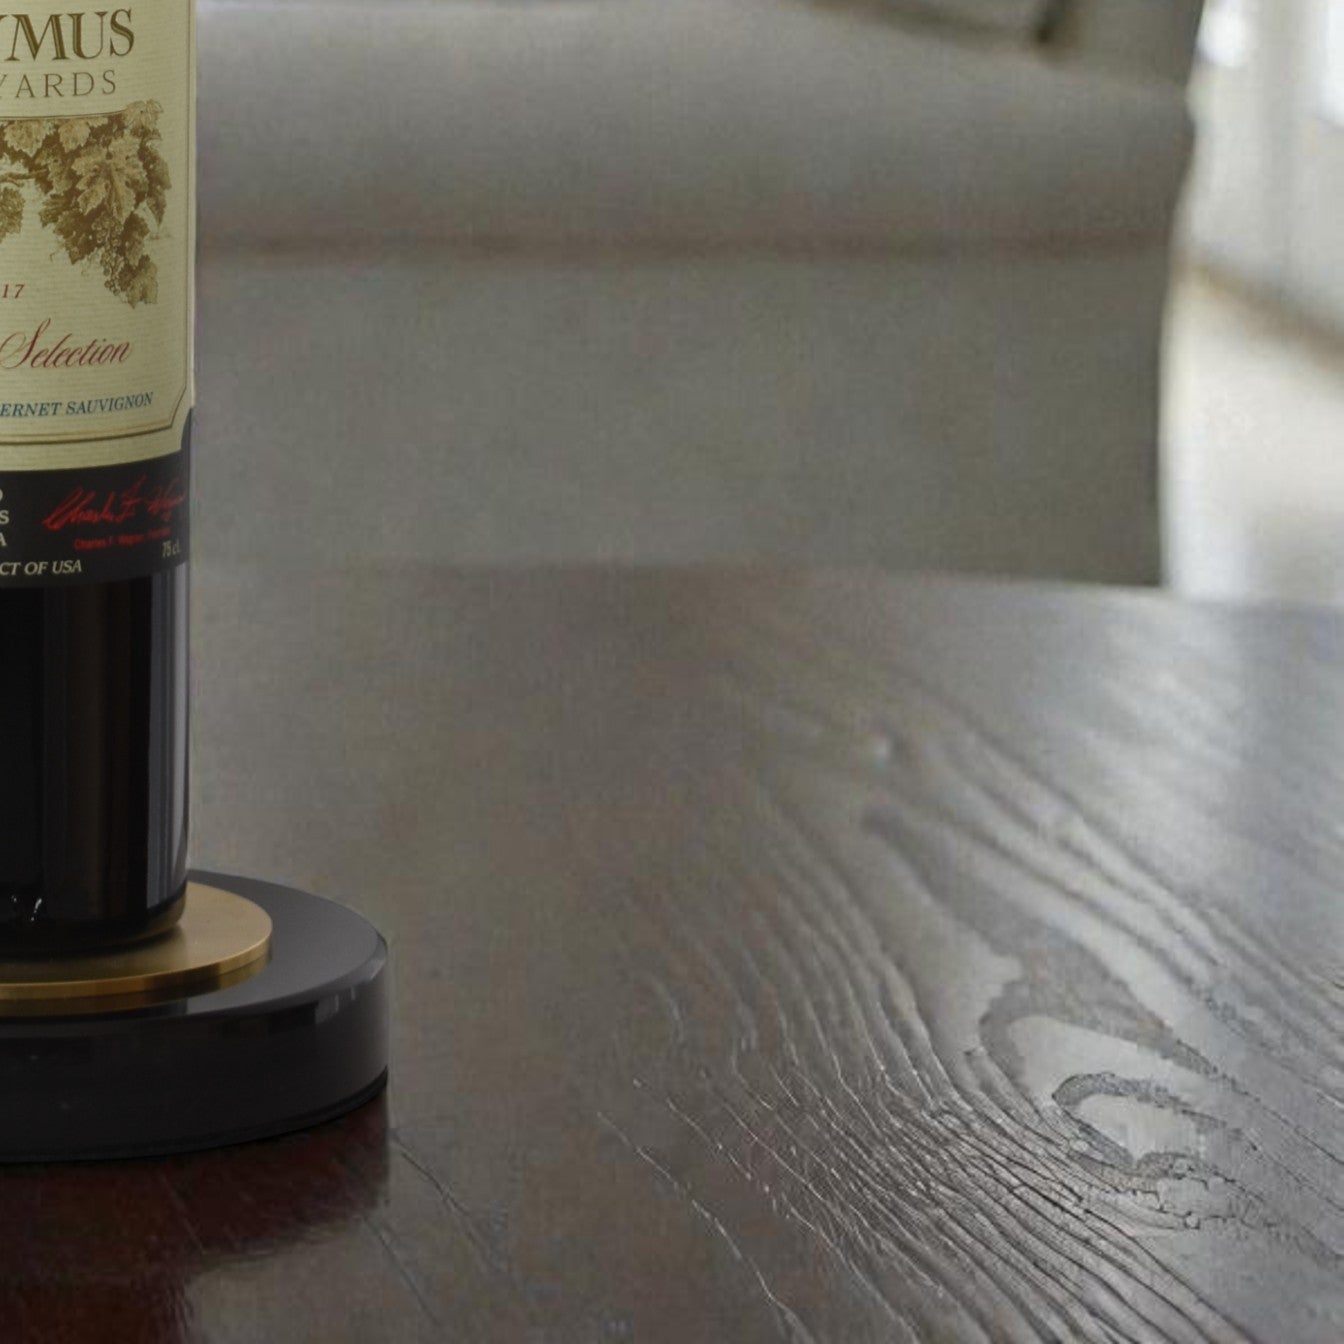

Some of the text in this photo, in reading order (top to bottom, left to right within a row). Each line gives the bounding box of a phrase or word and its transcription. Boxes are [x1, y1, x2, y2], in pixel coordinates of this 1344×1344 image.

[66, 391, 154, 415] SAUVIGNON
[24, 561, 47, 576] OF
[51, 559, 82, 574] USA
